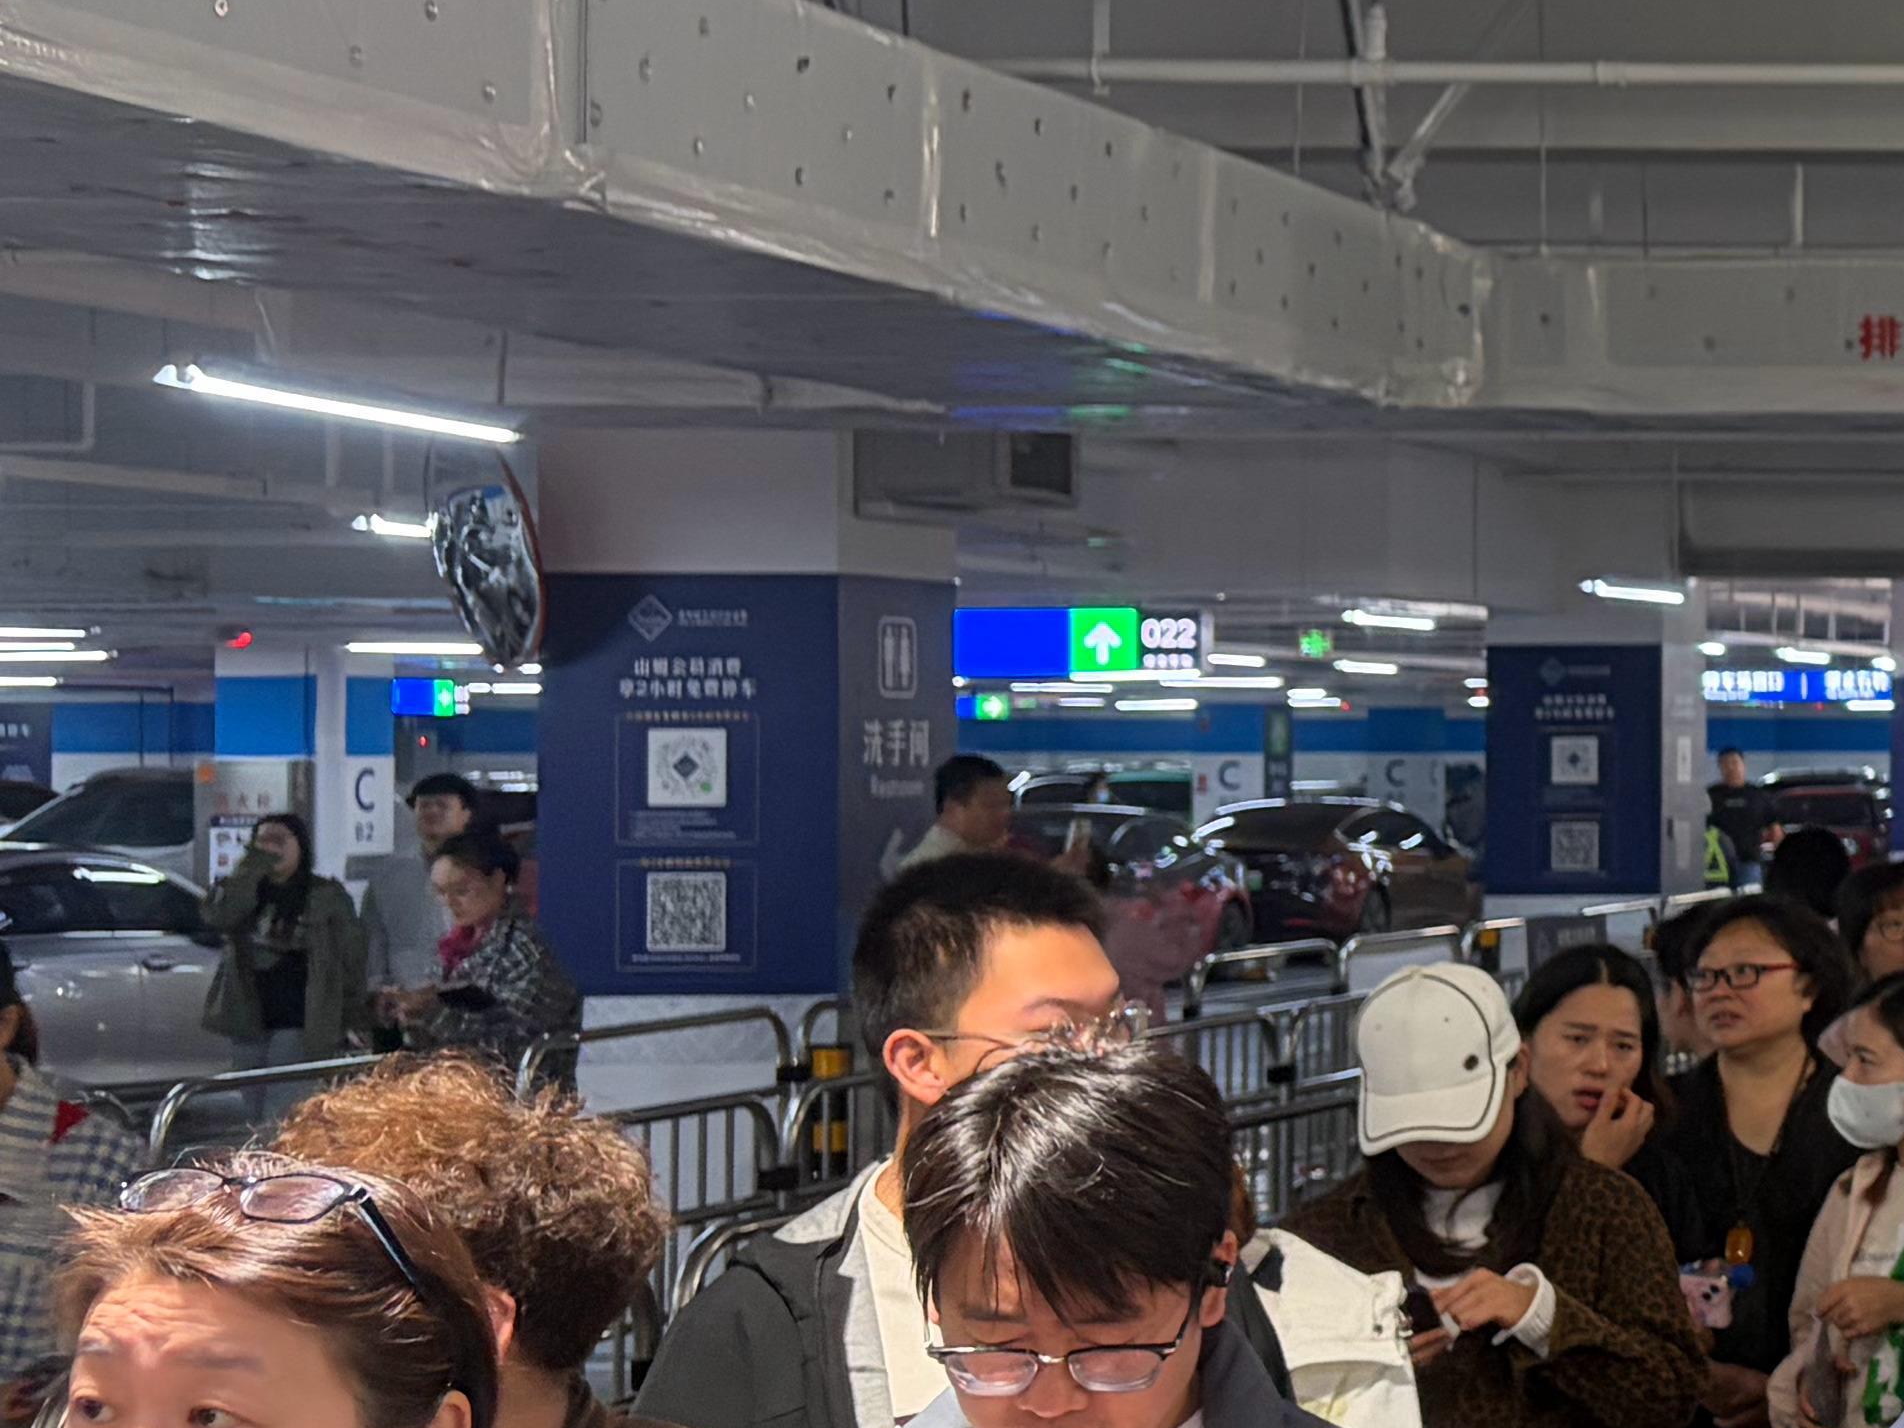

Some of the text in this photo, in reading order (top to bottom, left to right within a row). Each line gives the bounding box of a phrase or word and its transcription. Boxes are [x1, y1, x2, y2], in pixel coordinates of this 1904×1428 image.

[1141, 618, 1197, 649] 022
[863, 719, 930, 767] 洗手间
[355, 767, 375, 812] C
